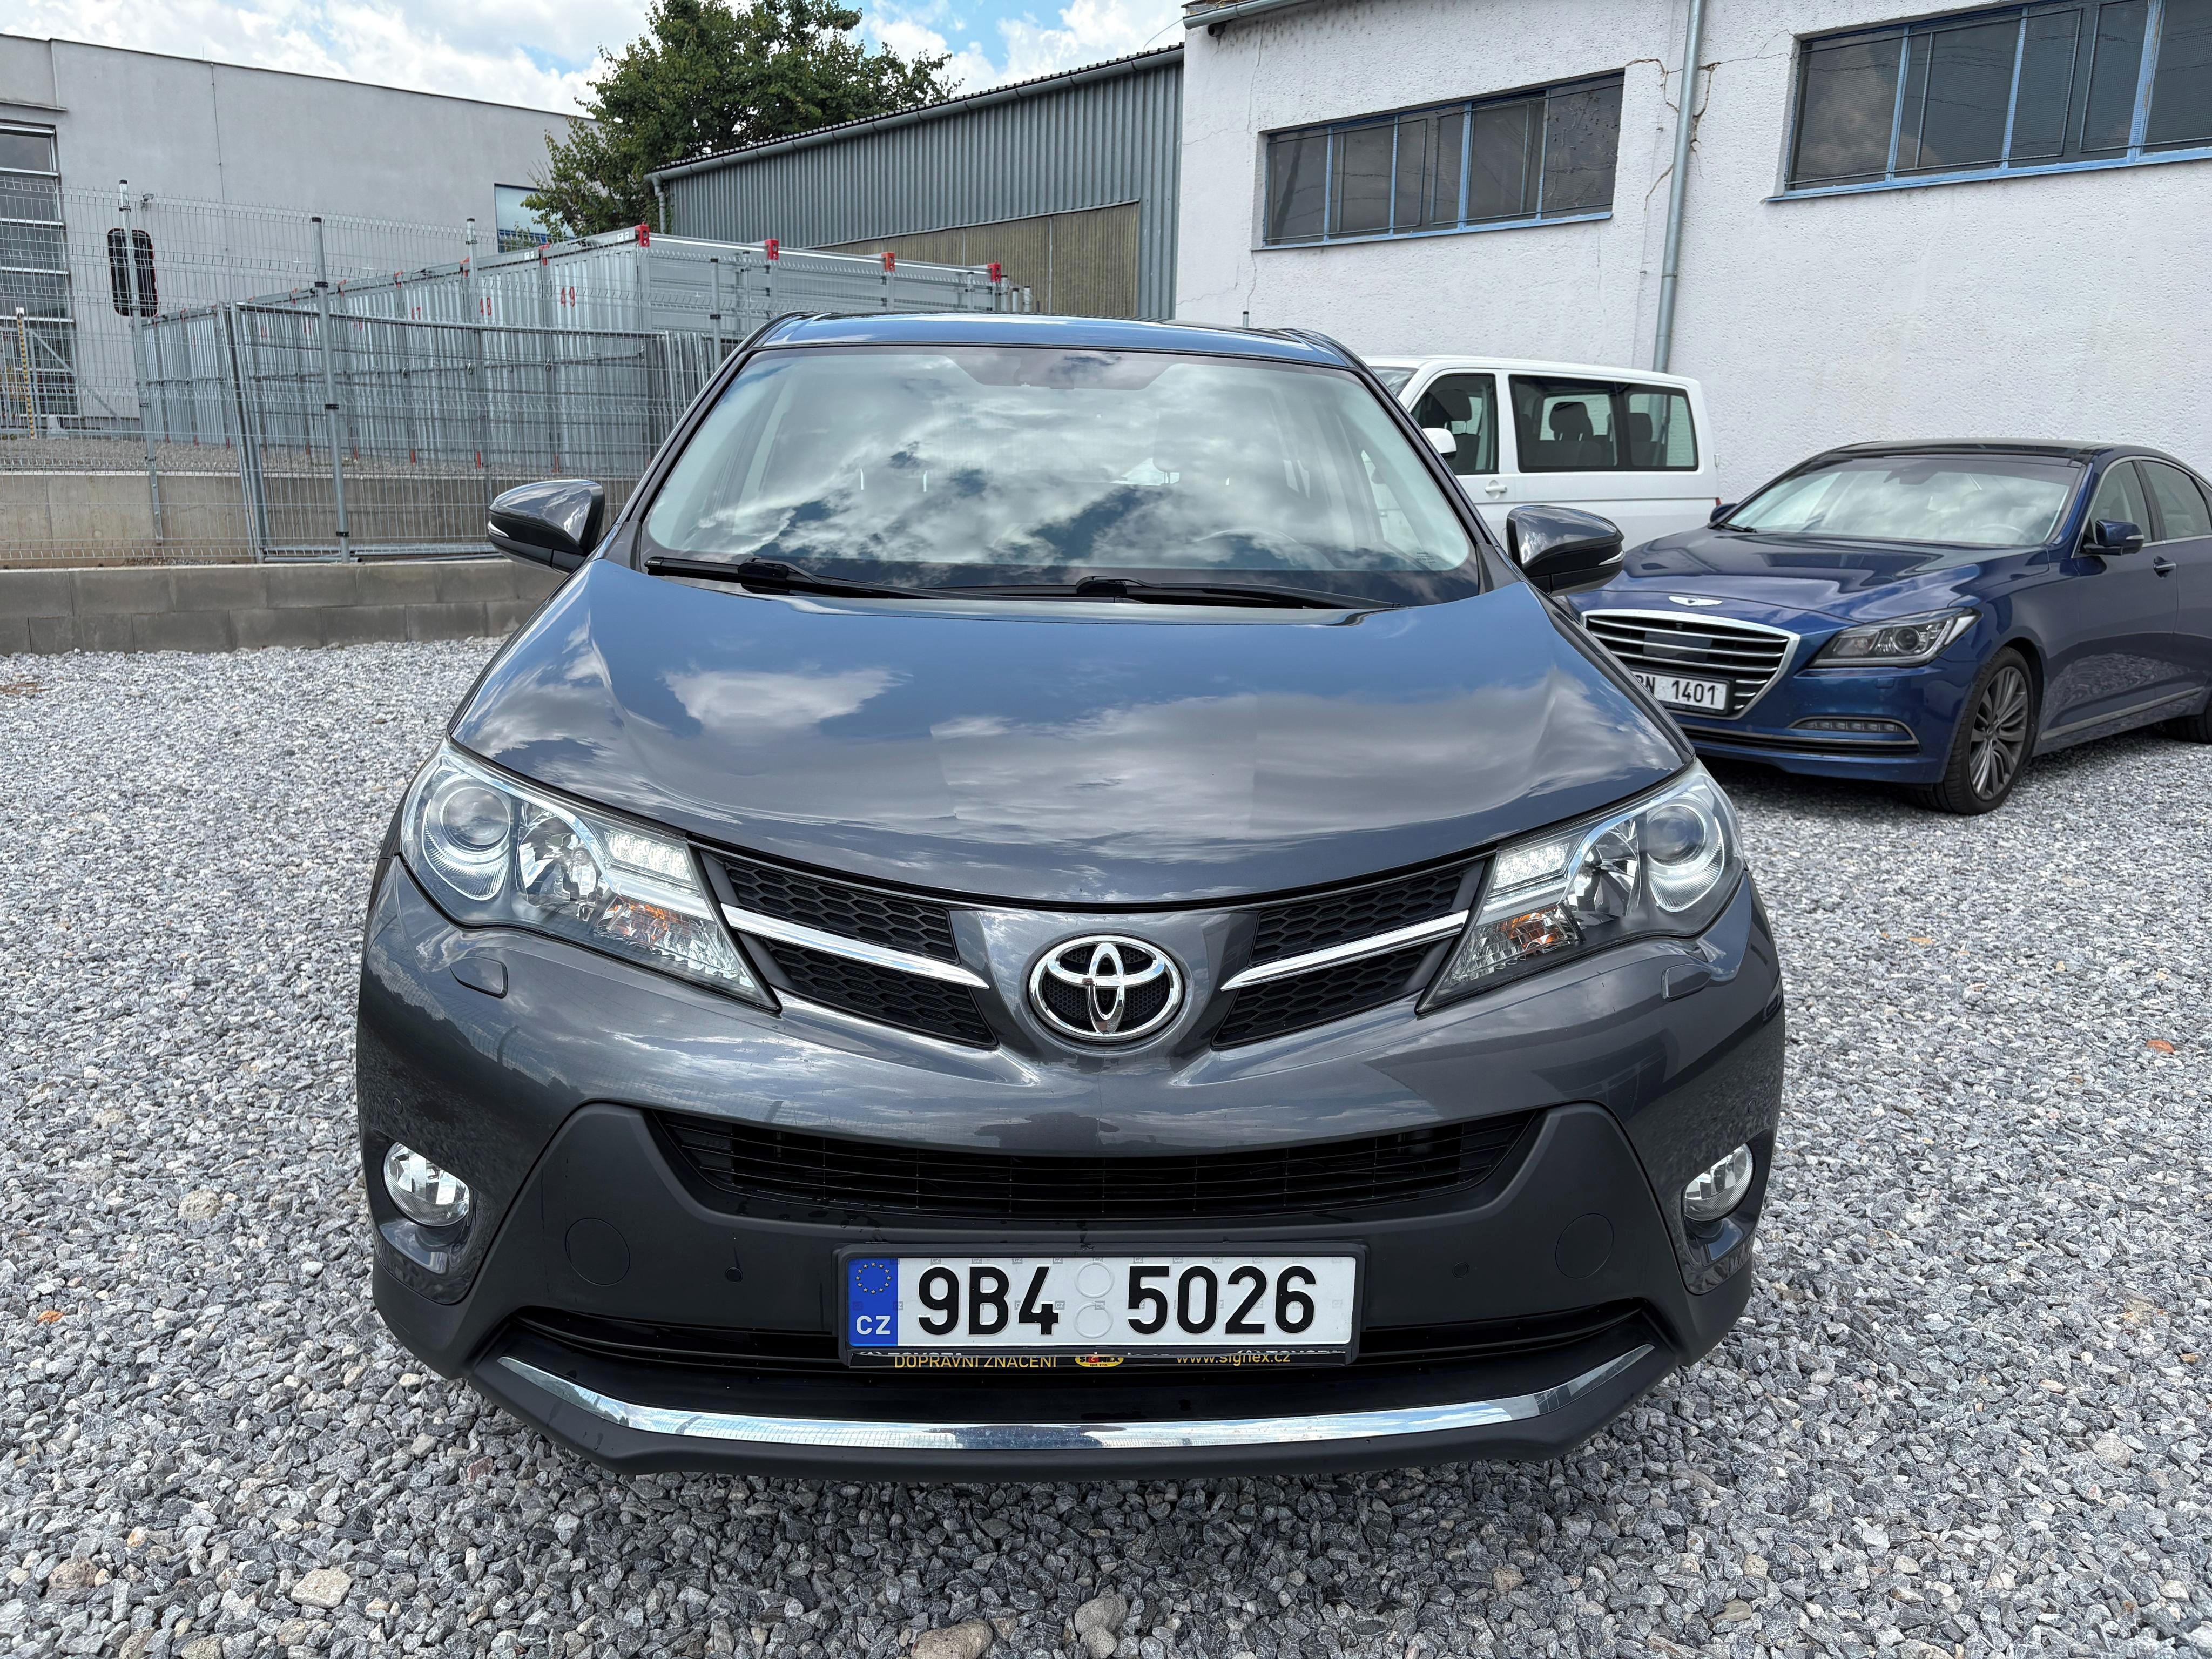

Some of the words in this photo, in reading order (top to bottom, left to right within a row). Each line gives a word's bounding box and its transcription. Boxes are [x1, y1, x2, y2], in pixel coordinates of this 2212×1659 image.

[561, 286, 575, 308] 49
[1671, 680, 1716, 705] 1401
[918, 1266, 1059, 1336] 9B4
[1128, 1265, 1316, 1335] 5026
[856, 1314, 891, 1335] CZ
